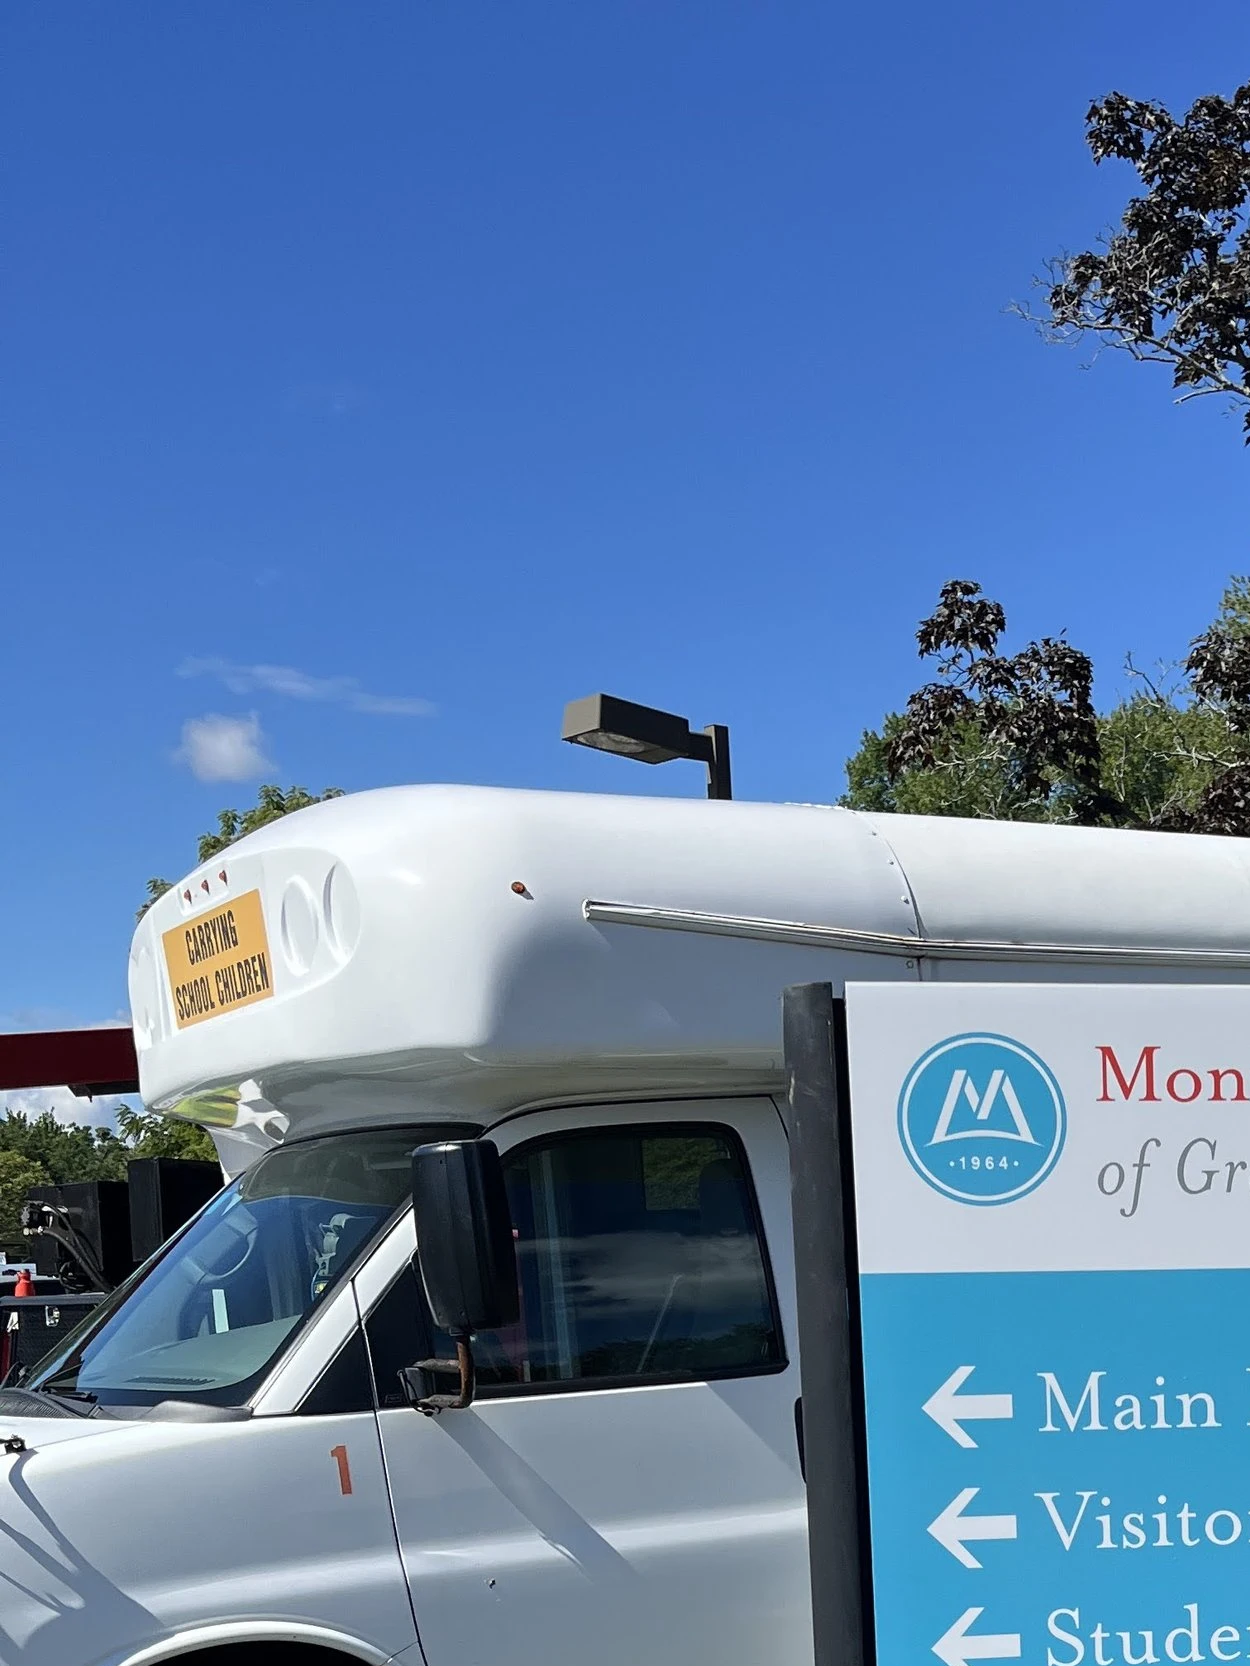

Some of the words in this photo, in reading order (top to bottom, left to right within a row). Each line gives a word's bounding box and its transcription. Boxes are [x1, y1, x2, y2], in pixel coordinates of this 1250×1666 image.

[185, 910, 238, 965] CARRYING
[175, 976, 215, 1020] SCHOOL
[215, 953, 269, 1005] CHILDREN
[1096, 1136, 1163, 1218] of
[1036, 1371, 1222, 1433] Main
[331, 1445, 352, 1495] 1
